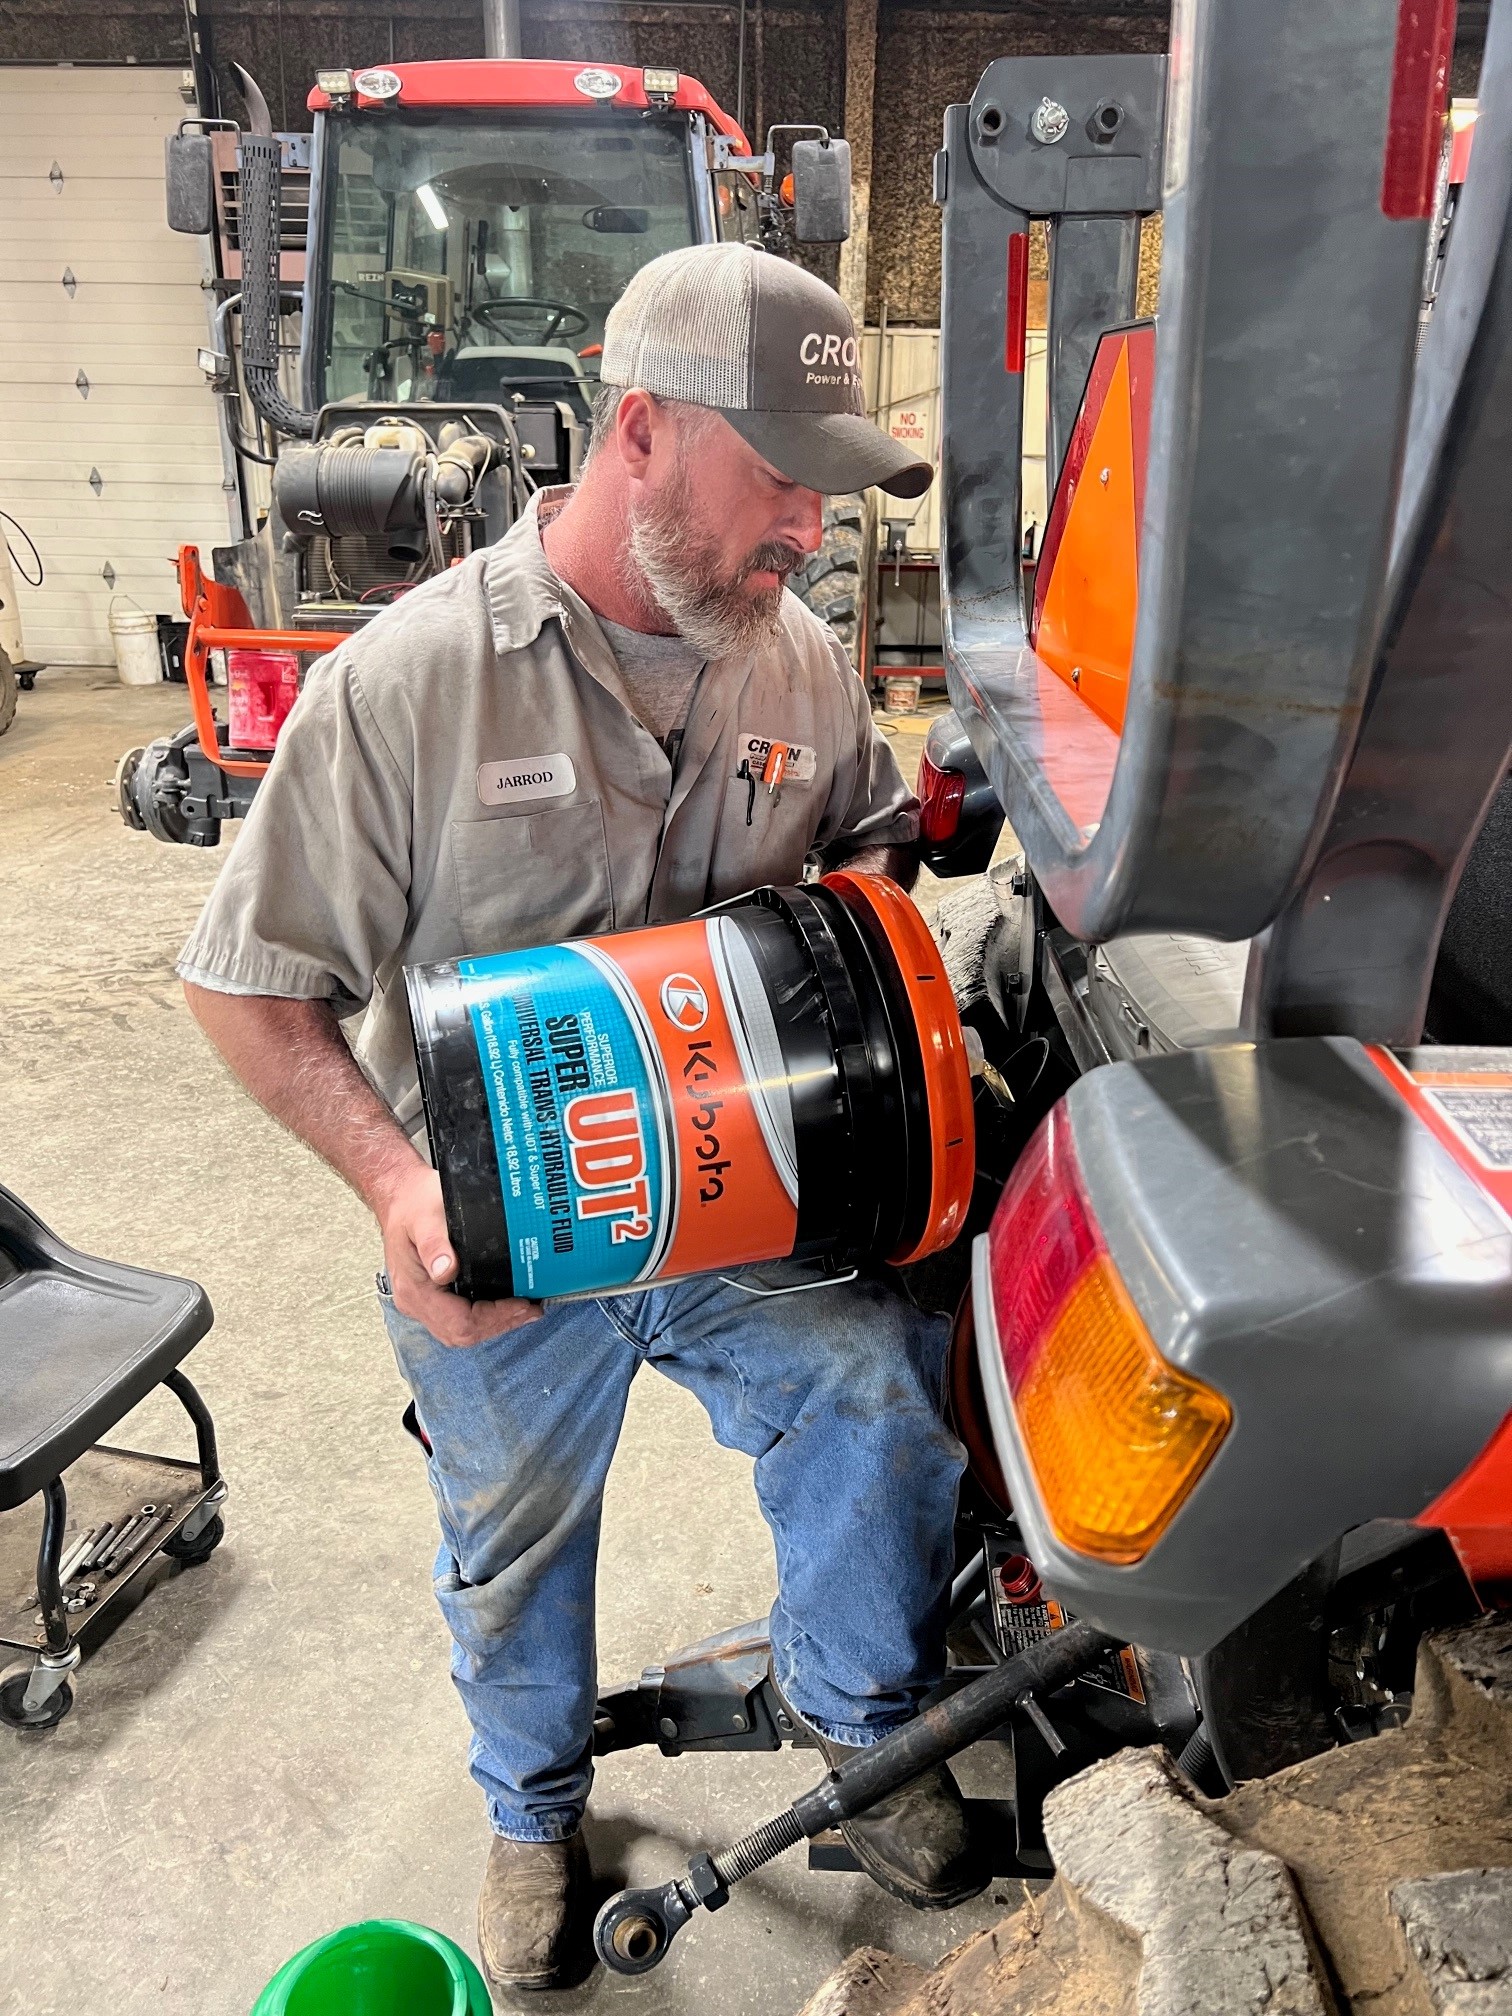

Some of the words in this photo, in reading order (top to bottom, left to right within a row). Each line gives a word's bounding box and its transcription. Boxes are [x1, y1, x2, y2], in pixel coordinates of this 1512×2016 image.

[805, 372, 842, 385] Power
[843, 372, 850, 385] &
[900, 413, 916, 425] NO
[891, 427, 924, 439] SMOKING
[748, 739, 802, 761] CRN
[497, 771, 553, 789] JARROD
[512, 992, 547, 1066] UNIVERSAL
[507, 1039, 519, 1059] Fully
[544, 1013, 591, 1093] SUPER
[581, 1011, 606, 1087] PERFORMANCE
[597, 1033, 618, 1085] SUPERIOR
[511, 1061, 529, 1110] compatible
[481, 1010, 494, 1035] Gallon
[493, 1070, 510, 1117] Contenido
[502, 1117, 513, 1143] Neto:
[510, 1171, 522, 1198] Litros
[521, 1110, 533, 1132] with
[683, 1040, 731, 1202] Kubota
[525, 1133, 537, 1153] UDT
[529, 1067, 571, 1215] TRANS-HYDRAULIC
[528, 1155, 538, 1163] &
[528, 1164, 541, 1191] Super
[533, 1192, 545, 1210] UDT
[551, 1217, 574, 1254] FLUID
